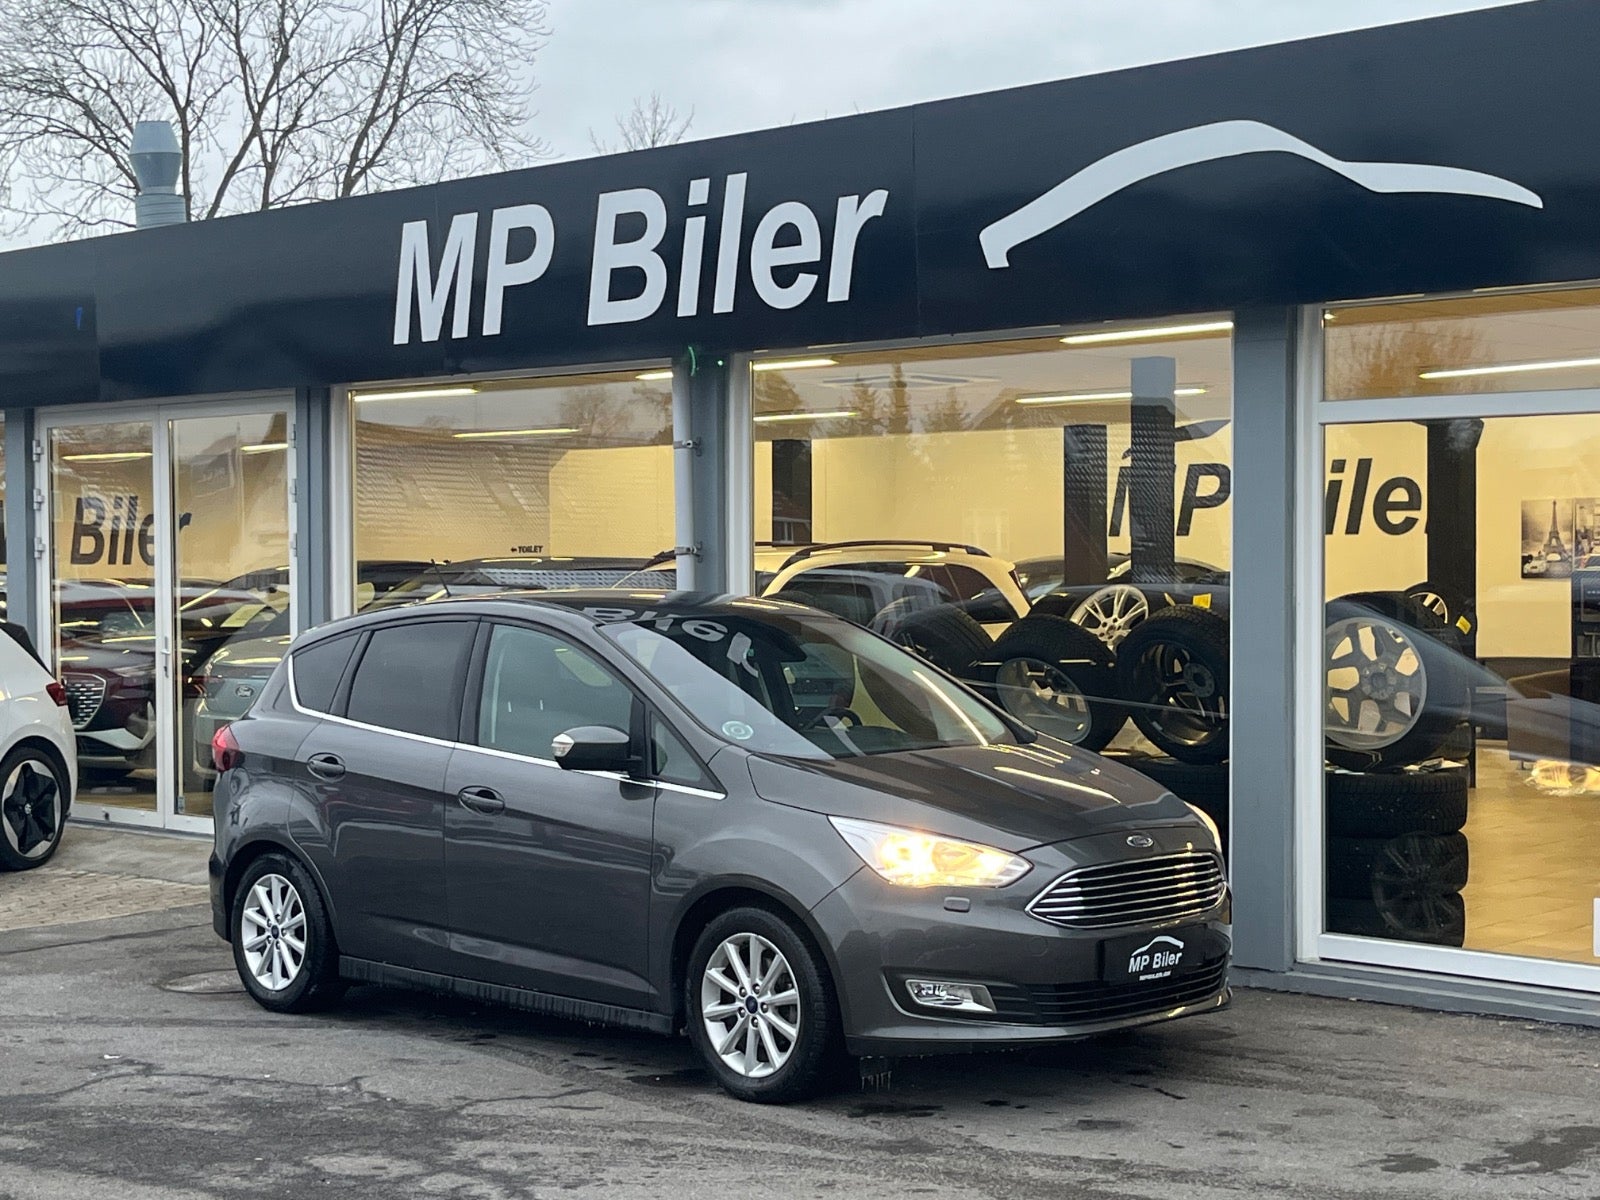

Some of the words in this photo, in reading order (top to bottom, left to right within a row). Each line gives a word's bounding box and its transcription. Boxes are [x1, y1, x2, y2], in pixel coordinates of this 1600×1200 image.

[393, 203, 555, 346] MP
[587, 173, 889, 326] Biler
[1324, 457, 1428, 536] ile
[517, 545, 544, 554] TOILET
[1128, 955, 1150, 973] MP
[1152, 951, 1182, 968] Biler
